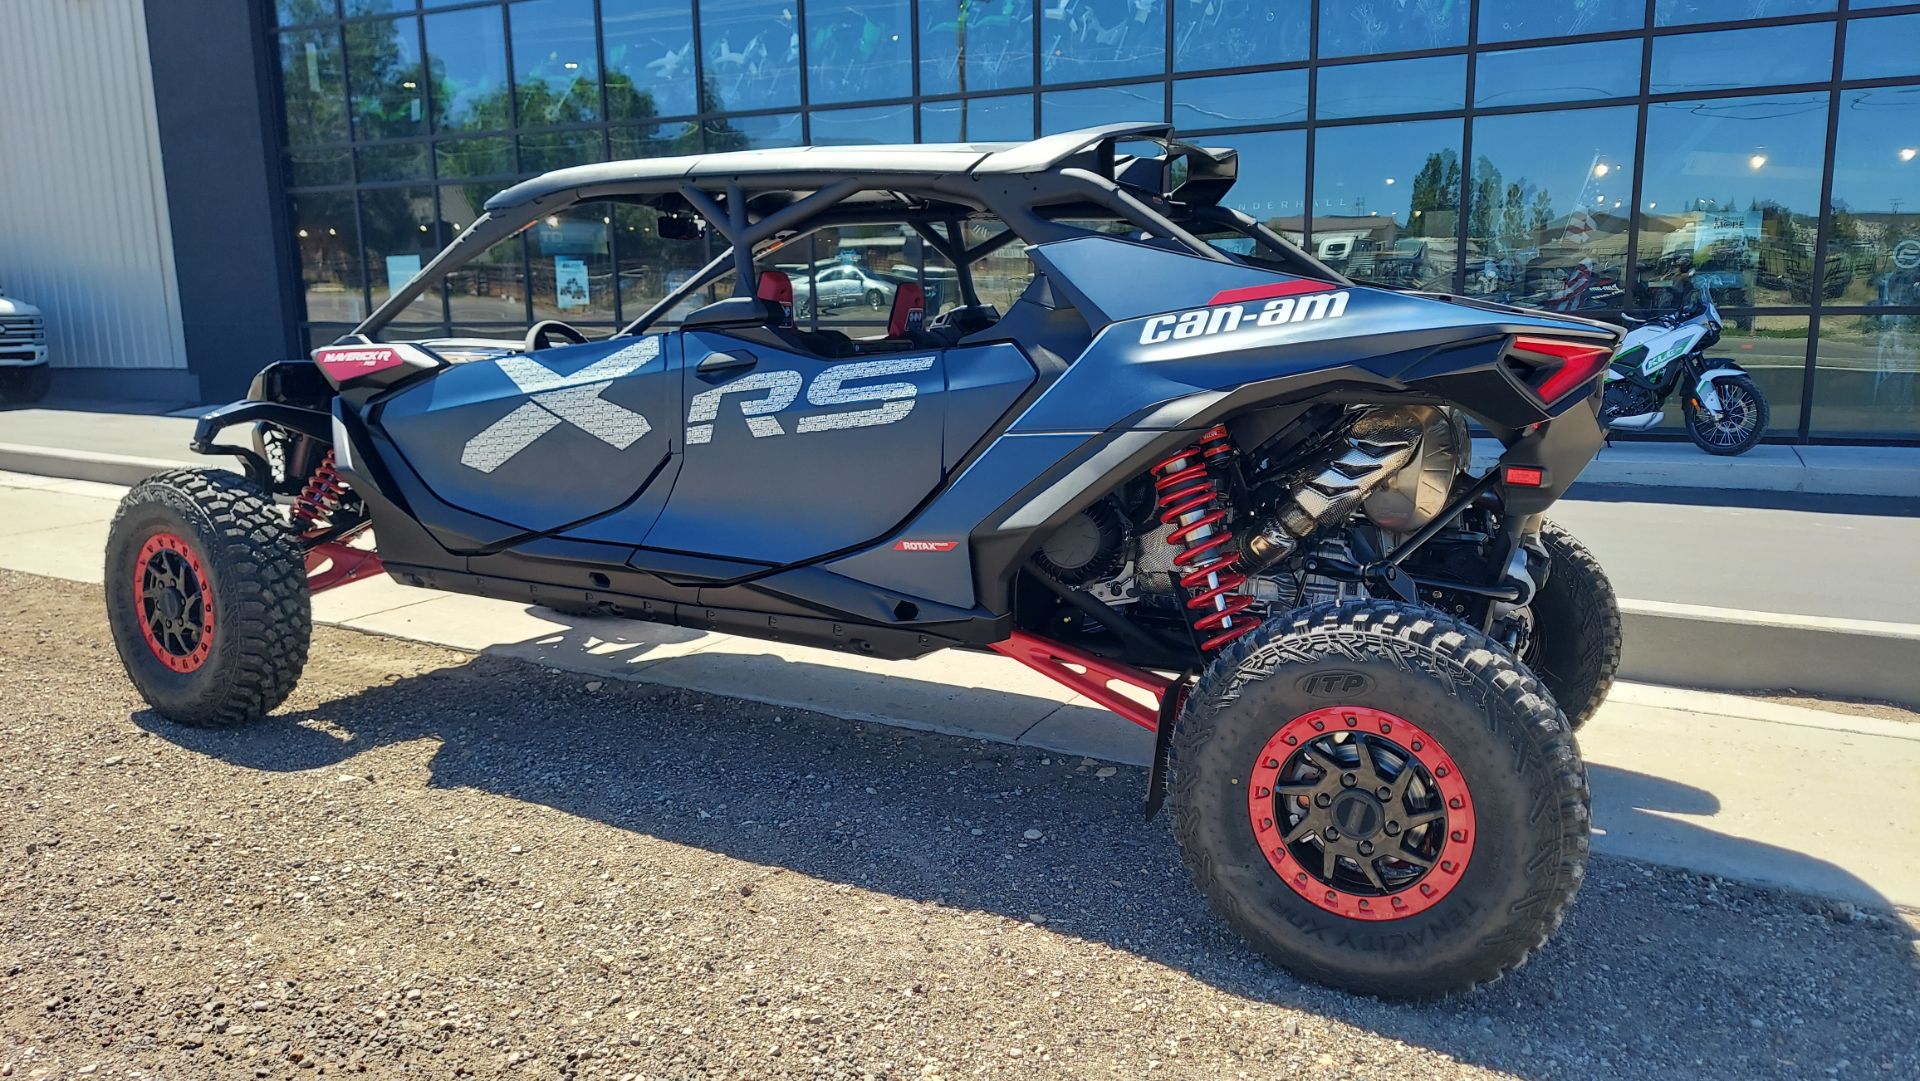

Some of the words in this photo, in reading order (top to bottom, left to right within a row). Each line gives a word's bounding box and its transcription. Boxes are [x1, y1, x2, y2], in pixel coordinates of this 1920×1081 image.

[1139, 291, 1350, 345] can-am
[324, 352, 377, 362] MAVERICK
[903, 541, 937, 551] ROTAX
[1305, 674, 1365, 695] ITP
[1336, 897, 1479, 952] TENACITY
